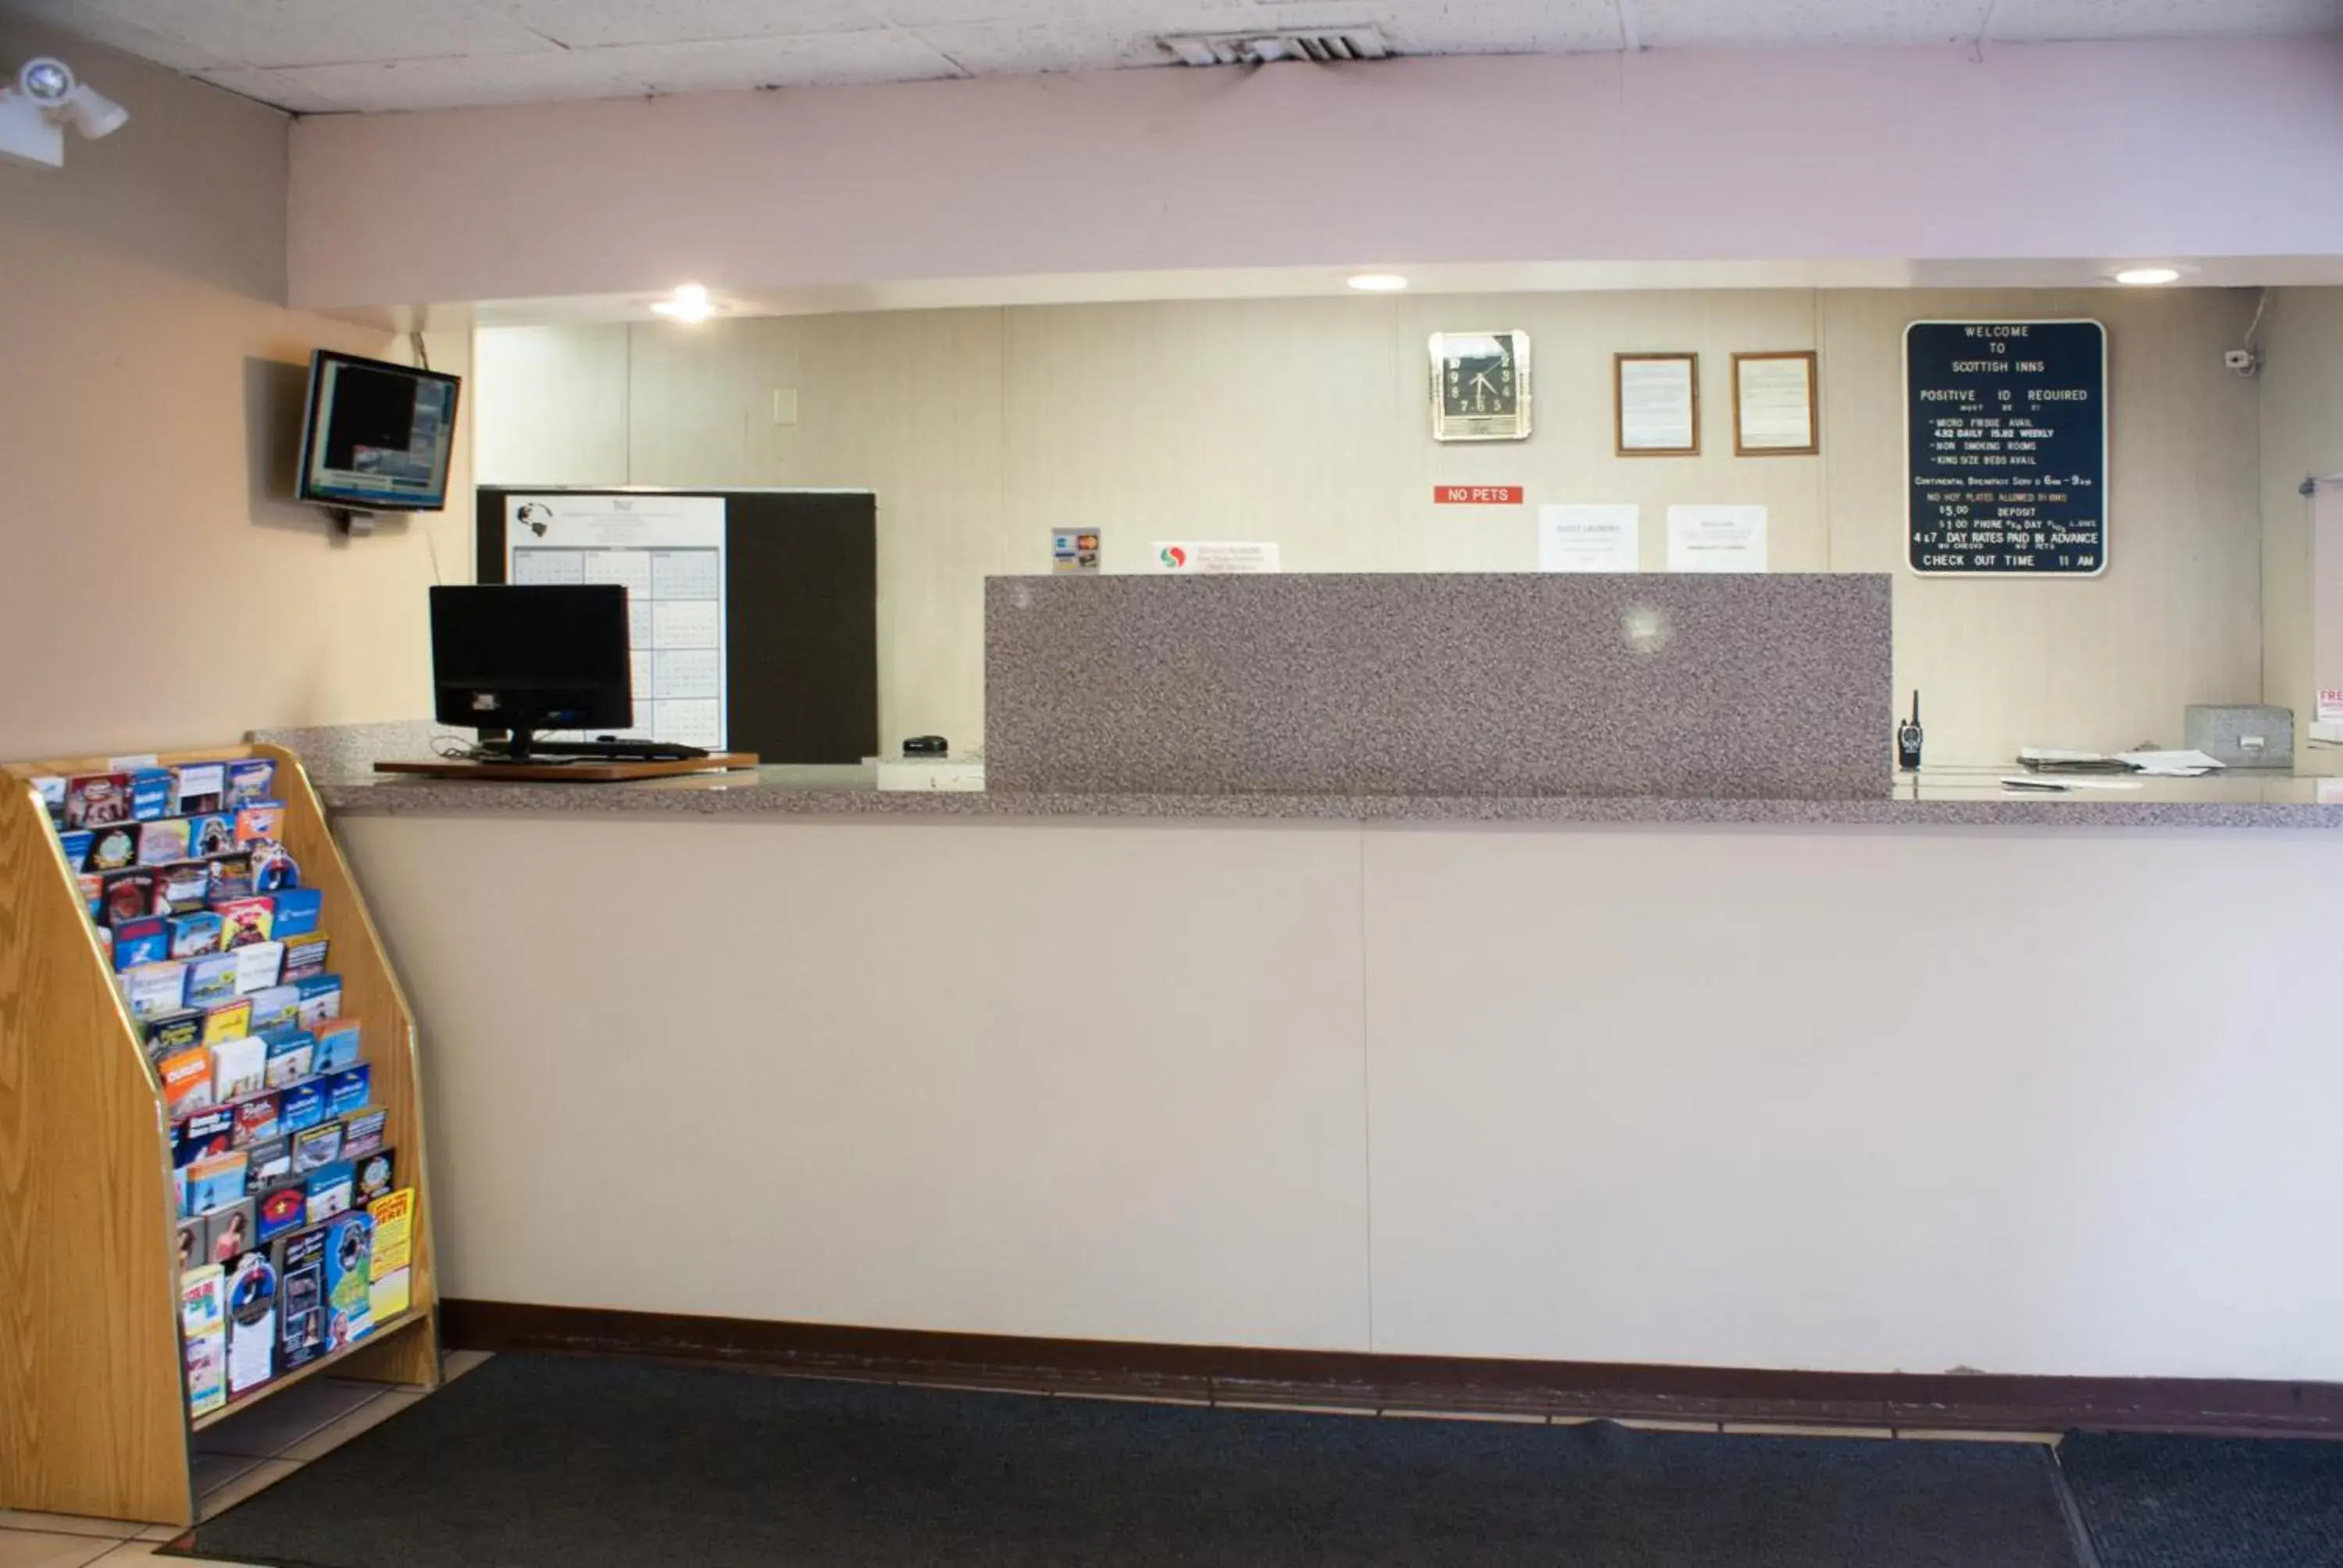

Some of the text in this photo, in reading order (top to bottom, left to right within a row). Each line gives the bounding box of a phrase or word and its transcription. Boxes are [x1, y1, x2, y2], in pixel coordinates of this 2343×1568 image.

[1964, 326, 2029, 337] WELCOME
[1989, 343, 2006, 354] TO
[1952, 362, 2045, 372] SCOTTISH INNS
[1920, 390, 2088, 401] POSITIVE ID REQUIRED
[1956, 429, 1984, 438] DAILY
[2019, 429, 2055, 438] WEEKLY
[1963, 441, 2000, 451] SMOKING
[2007, 441, 2036, 451] ROOMS
[1960, 455, 1980, 465] SIZE
[1983, 455, 2007, 465] BEDS
[1448, 487, 1510, 501] NO PETS
[1927, 493, 1942, 501] NO
[1944, 493, 1961, 501] HOT
[1965, 493, 1994, 502] PLATES
[1999, 493, 2035, 502] ALLOWED
[1997, 508, 2036, 517] DEPOSIT
[1974, 519, 2003, 529] PHONE
[2024, 519, 2042, 529] DAY
[1945, 532, 1967, 543] DAY
[1971, 532, 2005, 543] RATES
[2006, 532, 2031, 544] PAID
[2034, 532, 2045, 543] IN
[2050, 533, 2099, 544] ADVANCE
[1922, 555, 2095, 566] CHECK OUT TIME 11 AM
